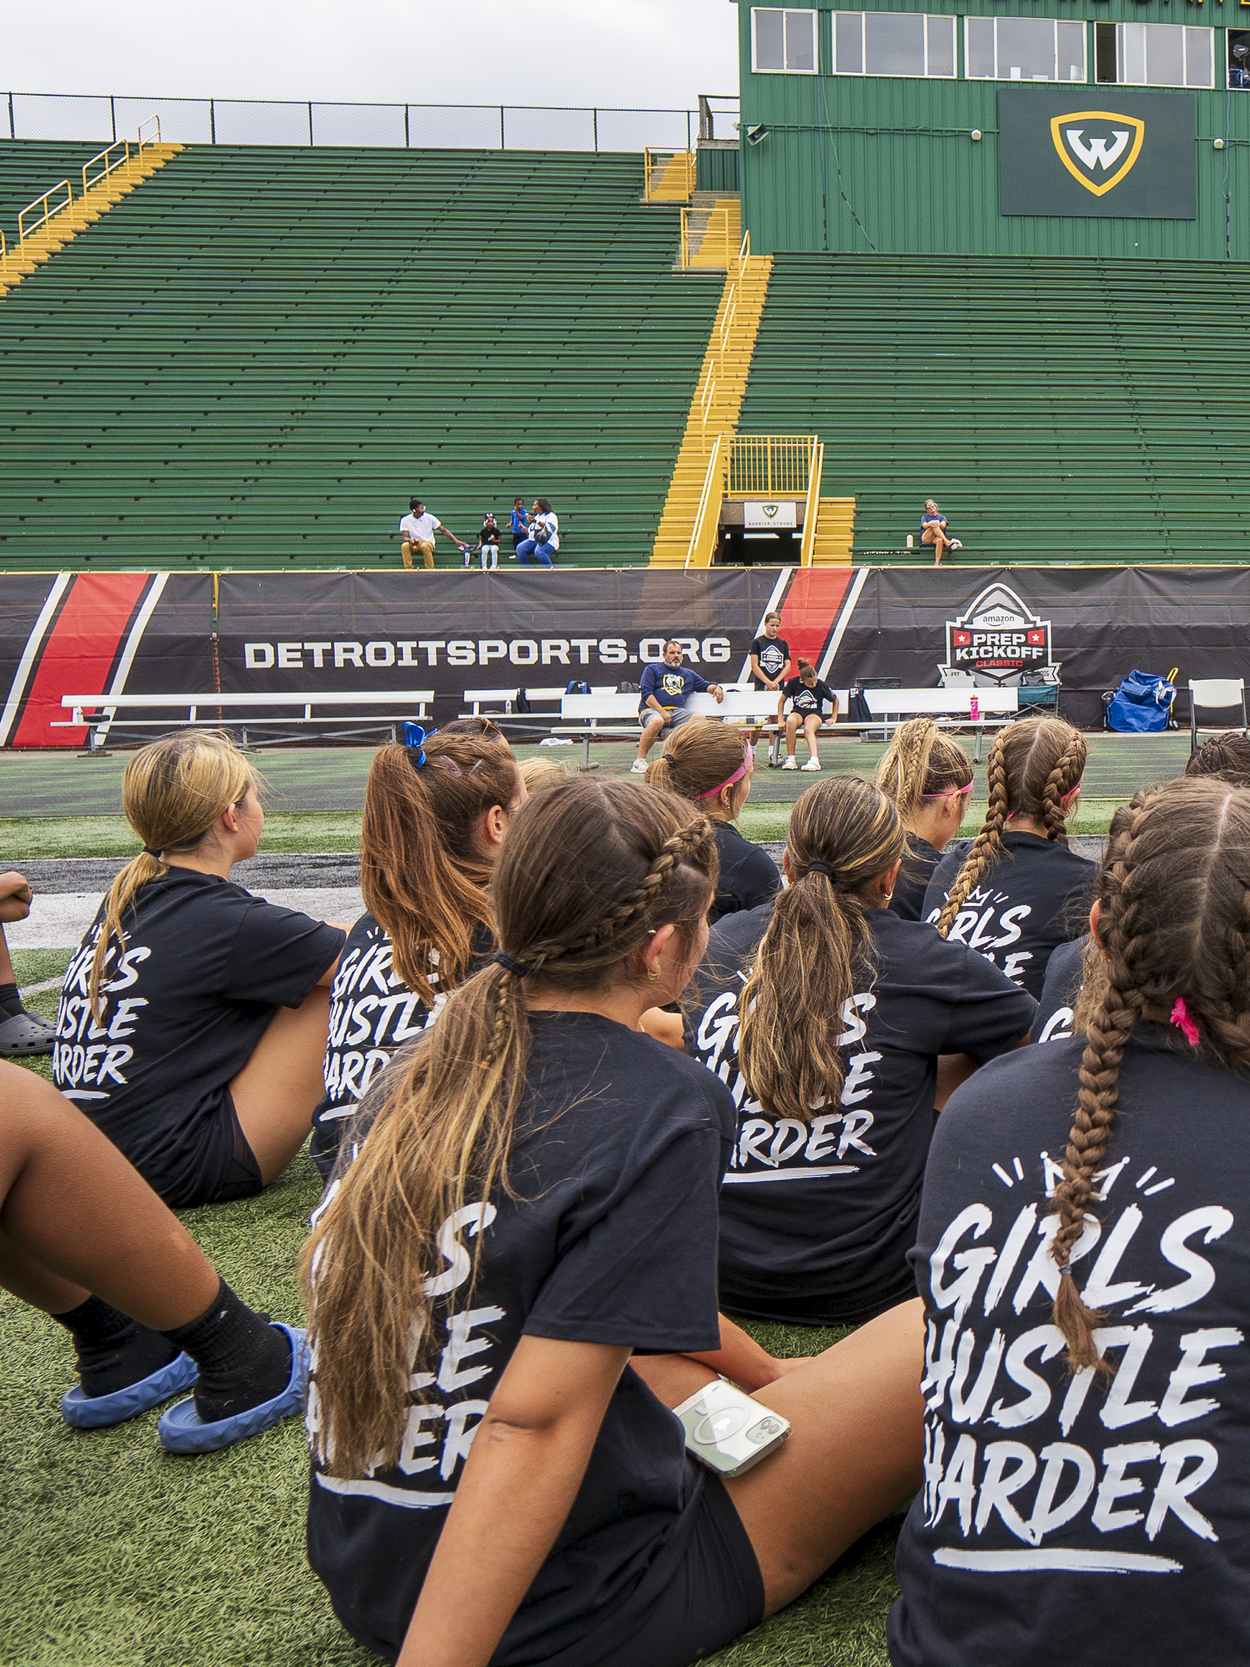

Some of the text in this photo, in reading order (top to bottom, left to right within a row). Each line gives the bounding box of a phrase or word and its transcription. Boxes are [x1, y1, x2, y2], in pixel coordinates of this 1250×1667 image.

[955, 645, 1044, 661] KICKOFF
[972, 633, 1026, 646] PREP
[976, 660, 1024, 668] CLASSIC
[925, 905, 1032, 950] RLS
[731, 1109, 877, 1169] RDER
[929, 1202, 1235, 1318] GIRLS
[920, 1318, 1245, 1438] HUSTLE
[923, 1421, 1220, 1548] HARDER
